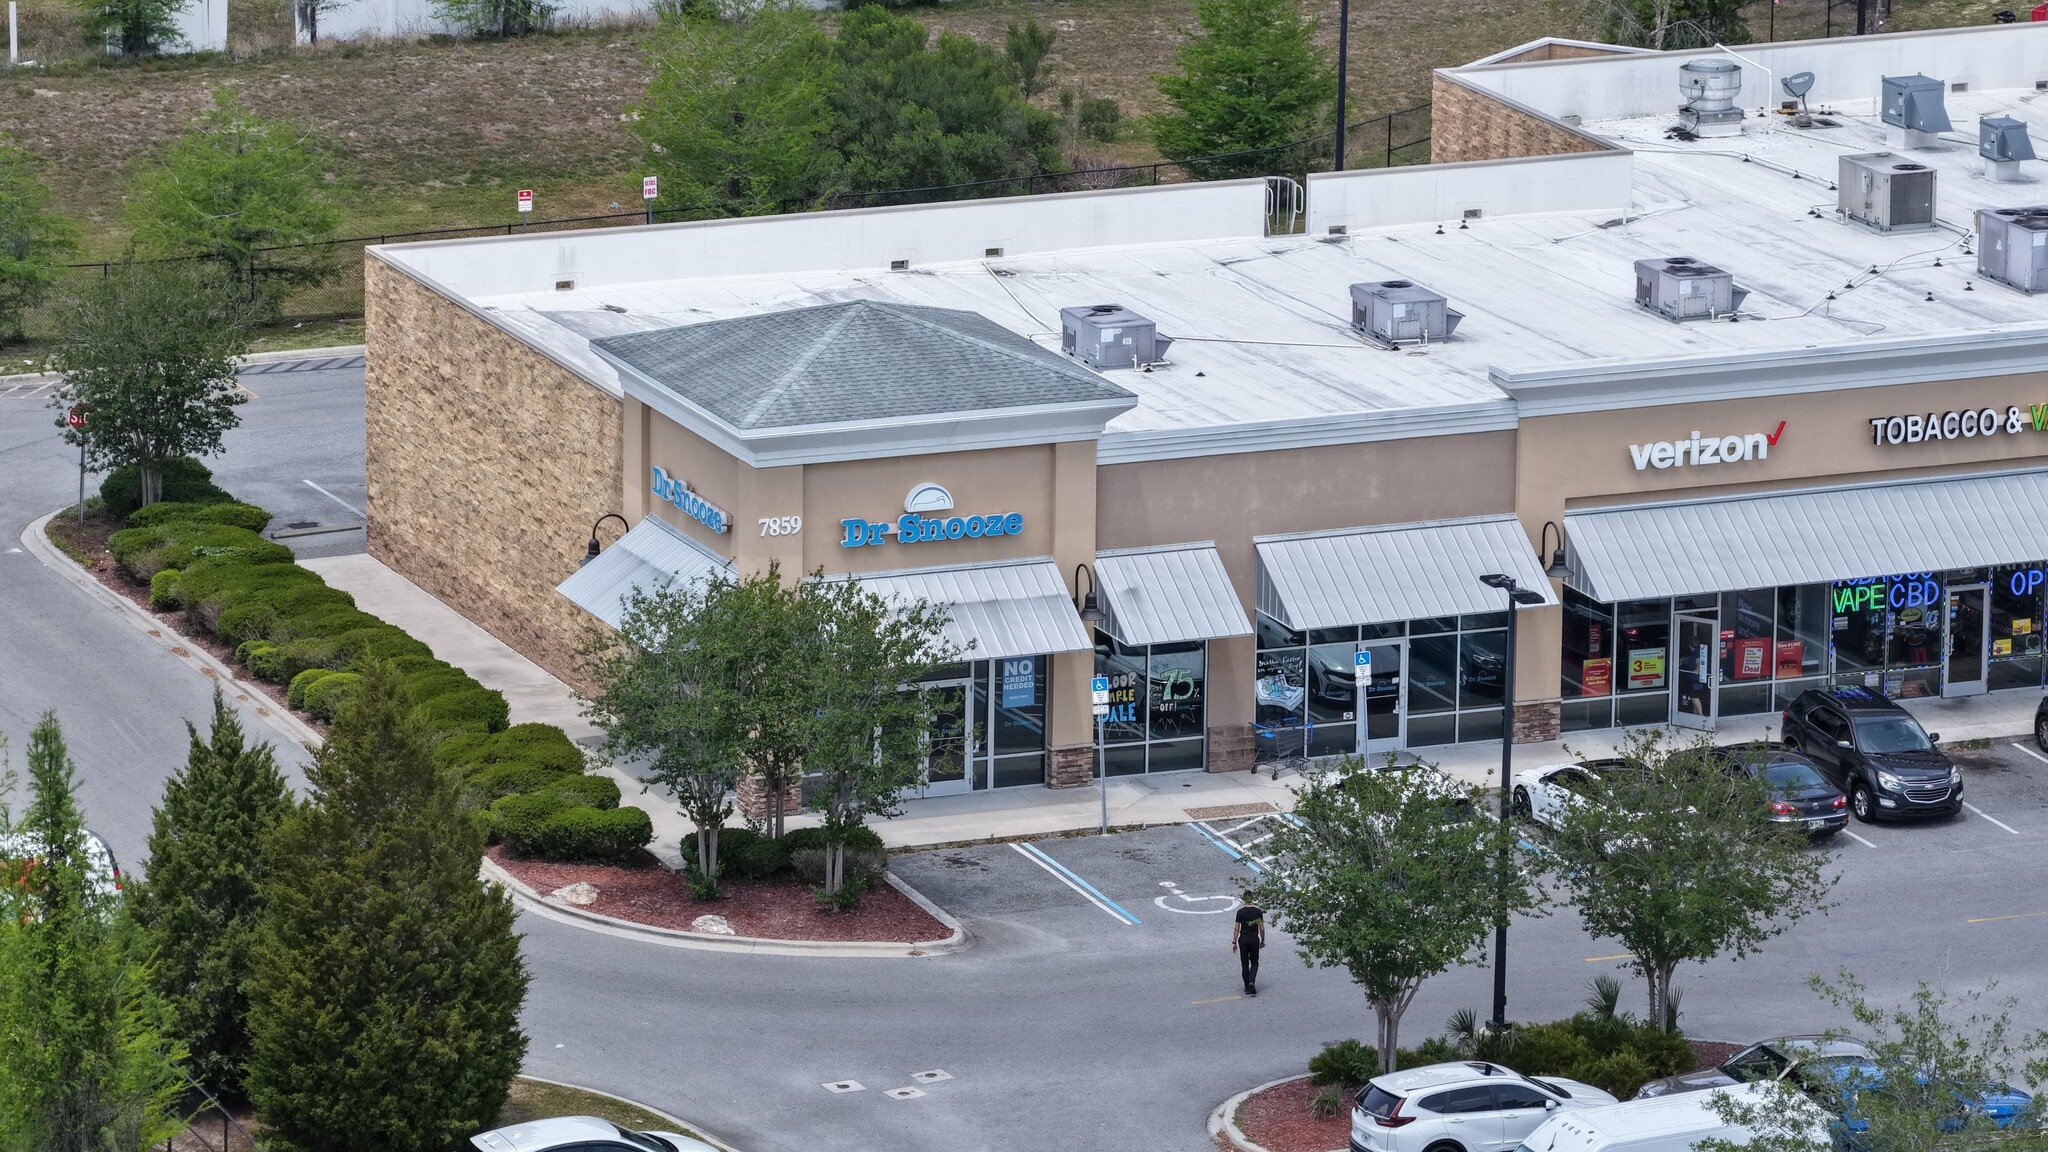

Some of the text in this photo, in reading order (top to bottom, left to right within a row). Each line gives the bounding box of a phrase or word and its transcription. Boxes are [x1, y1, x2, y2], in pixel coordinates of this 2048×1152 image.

[1870, 402, 2048, 446] TOBACCO & V
[1629, 430, 1768, 470] verizon
[652, 466, 727, 535] Dr Snooze
[758, 515, 803, 537] 7859
[840, 512, 1024, 548] Dr Snooze
[2011, 570, 2048, 596] OP
[1833, 580, 1940, 613] VAPE CBD
[1004, 660, 1033, 676] NO
[1633, 660, 1643, 673] 3
[1744, 665, 1760, 673] Deal
[1003, 682, 1034, 691] NEEDED
[1004, 675, 1033, 684] CREDIT
[1109, 671, 1137, 689] OOR
[1109, 689, 1135, 703] MPLE
